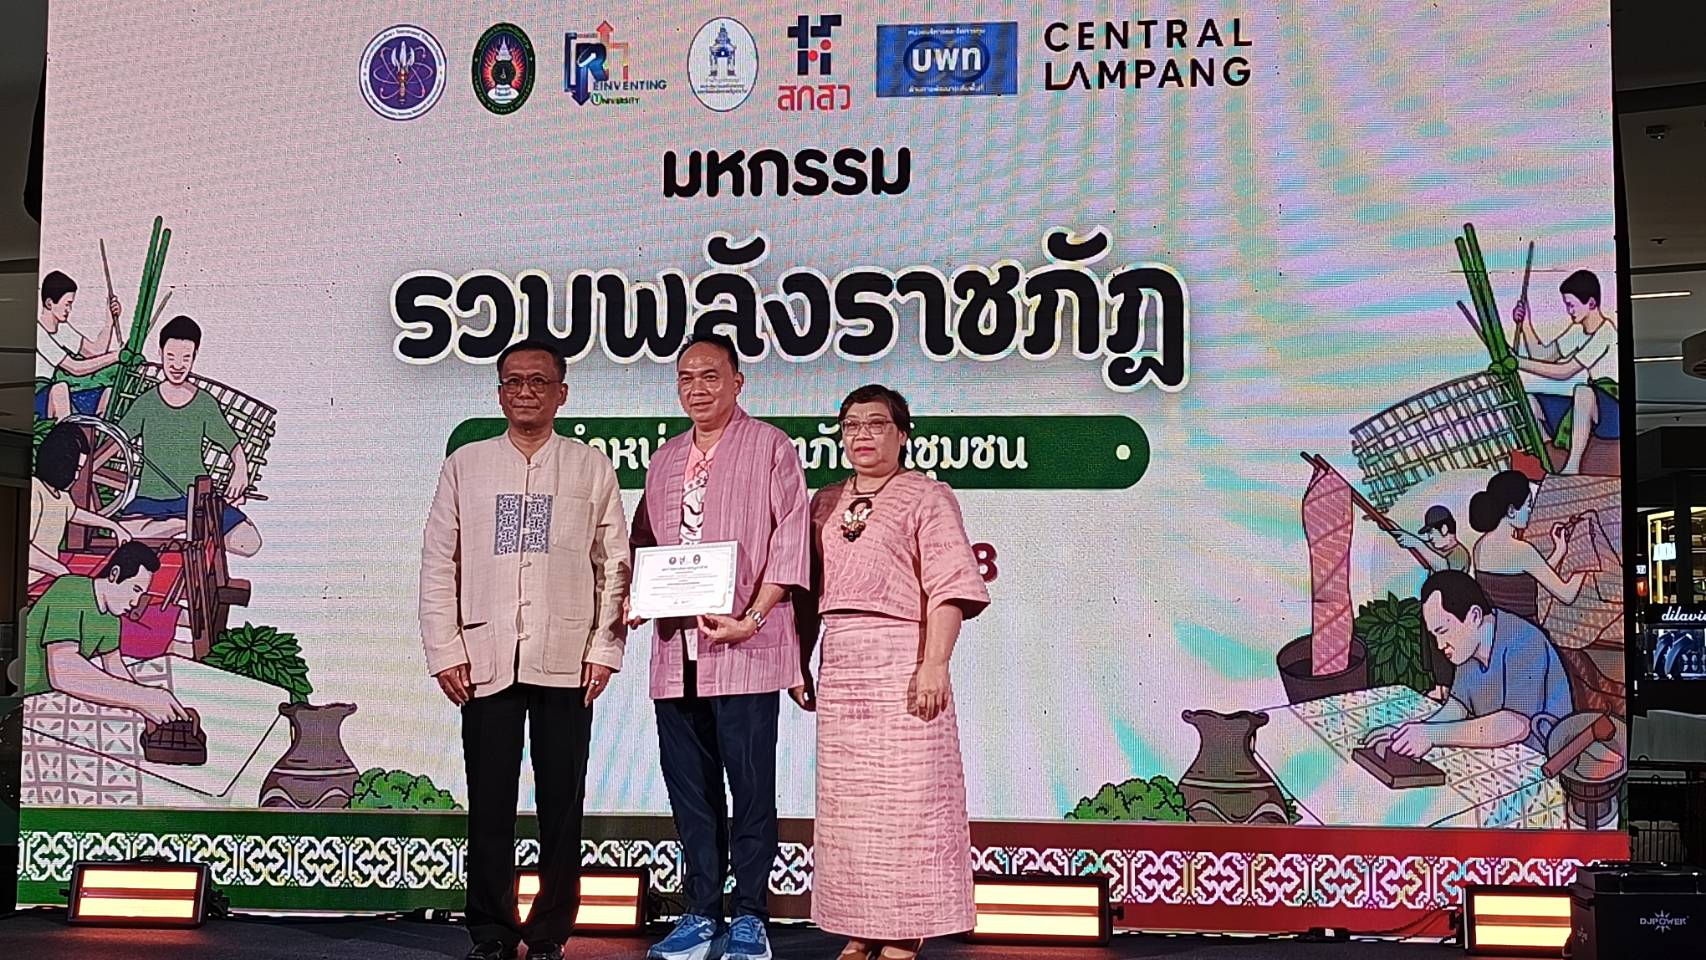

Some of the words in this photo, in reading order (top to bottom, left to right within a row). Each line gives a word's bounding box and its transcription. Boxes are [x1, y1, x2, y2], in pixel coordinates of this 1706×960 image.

[1044, 18, 1252, 52] CENTRAL
[911, 47, 982, 73] บพท
[1045, 57, 1251, 90] LAMPANG
[777, 84, 851, 111] สกสว
[663, 147, 911, 198] มหกรรม
[394, 233, 1186, 388] รวมพลังราชภัฏ
